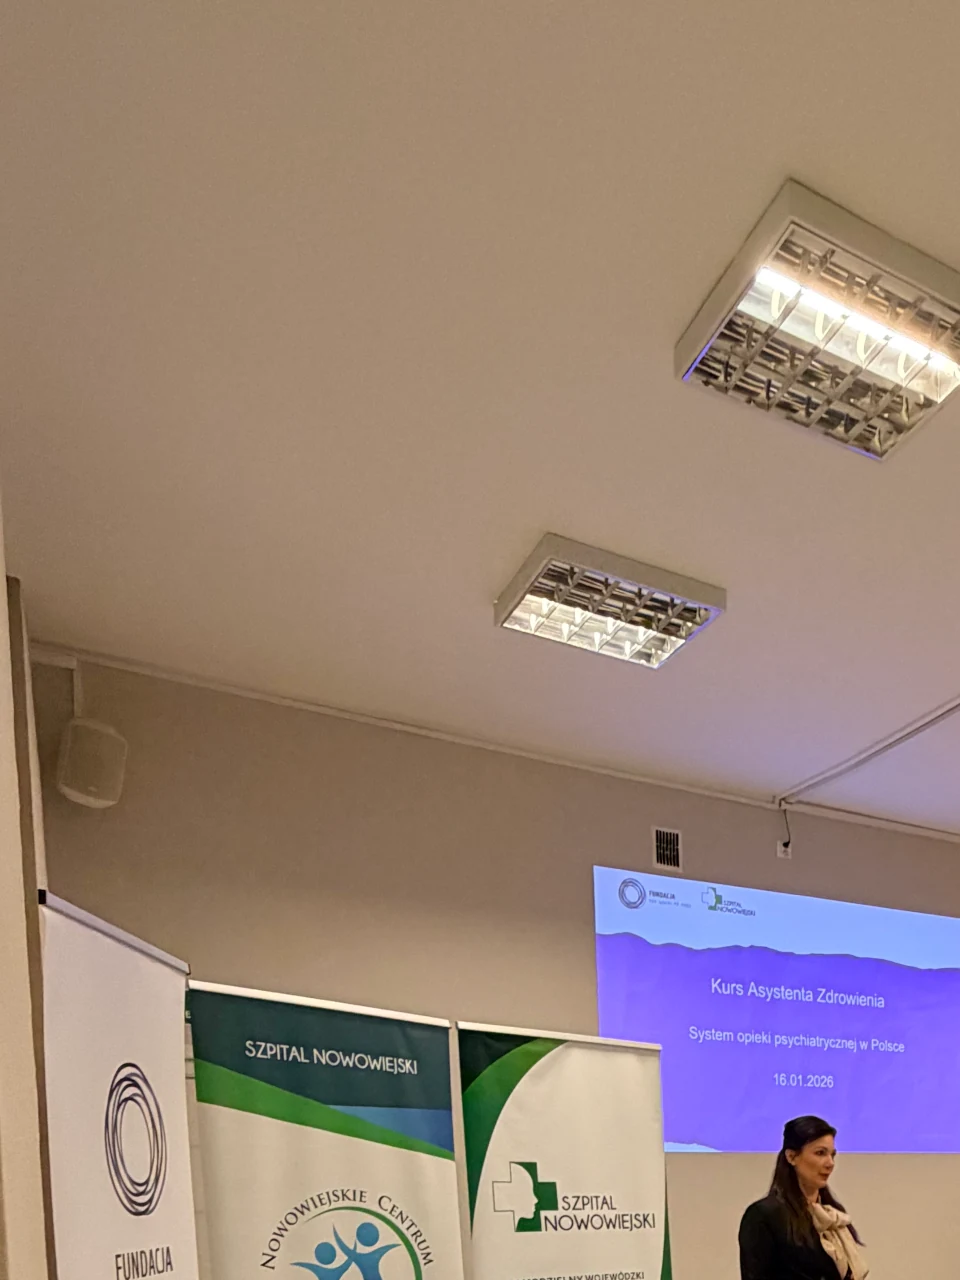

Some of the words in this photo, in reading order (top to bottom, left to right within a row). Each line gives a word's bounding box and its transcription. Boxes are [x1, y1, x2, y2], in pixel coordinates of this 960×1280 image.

[711, 978, 744, 996] Kurs
[747, 982, 813, 1002] Asystenta
[816, 988, 885, 1008] Zdrowienia
[689, 1026, 734, 1042] System
[737, 1030, 771, 1045] opieki
[774, 1033, 857, 1053] psychiatrycznej
[859, 1040, 868, 1050] w
[871, 1039, 905, 1052] Polsce
[245, 1040, 309, 1063] SZPITAL
[313, 1048, 418, 1075] NOWOWIEJSKI
[773, 1073, 834, 1089] 16.01.2026
[561, 1195, 617, 1211] SZPITAL
[260, 1188, 367, 1270] NOWOWIEJSKIE
[378, 1195, 434, 1266] CENTRUM
[544, 1213, 656, 1232] NOWOWIEJSKI
